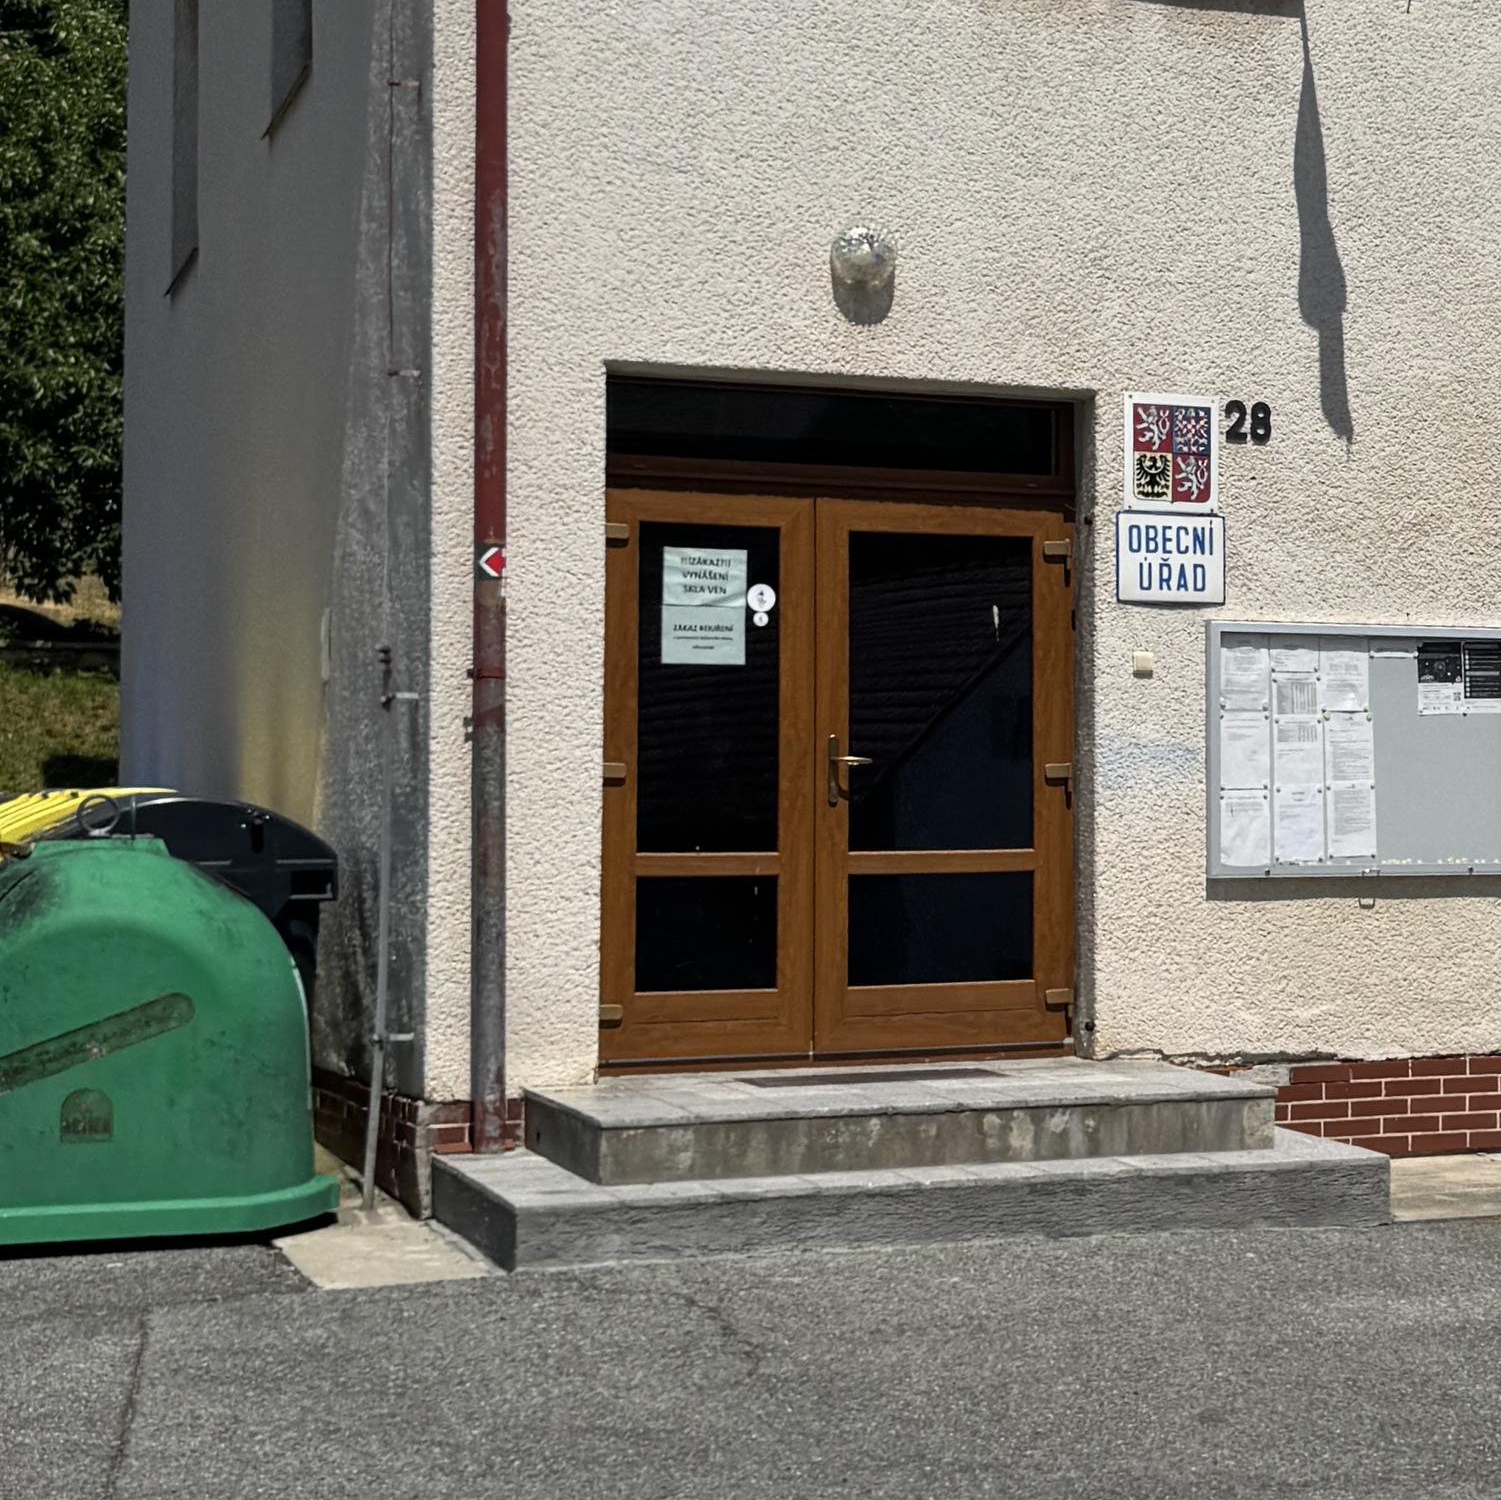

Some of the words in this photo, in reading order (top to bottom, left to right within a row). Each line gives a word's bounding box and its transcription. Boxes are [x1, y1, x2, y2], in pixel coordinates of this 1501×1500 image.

[1224, 399, 1272, 445] 28
[1127, 520, 1214, 556] OBECNÍ
[1138, 557, 1207, 593] ÚŘAD
